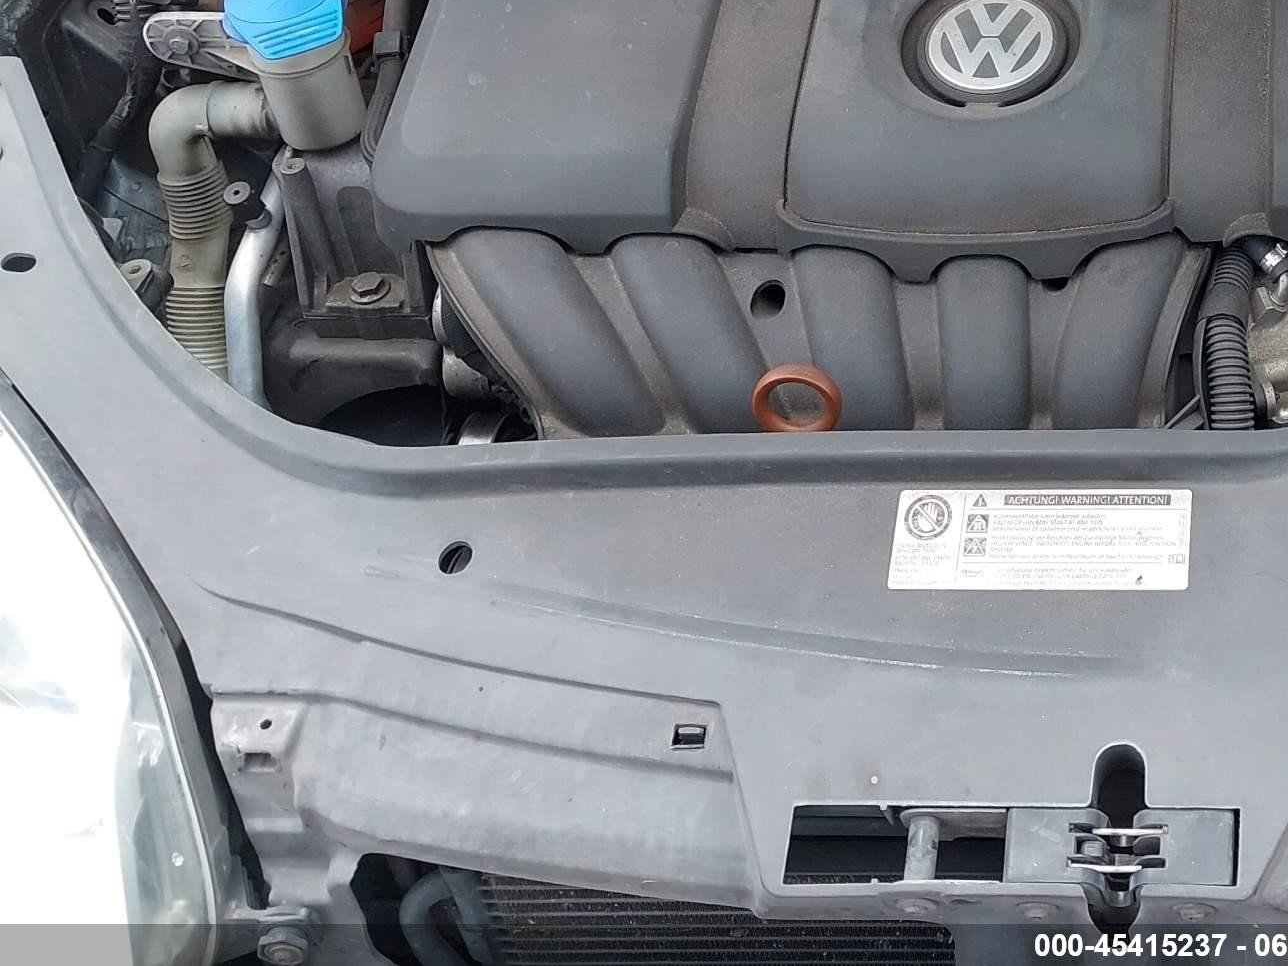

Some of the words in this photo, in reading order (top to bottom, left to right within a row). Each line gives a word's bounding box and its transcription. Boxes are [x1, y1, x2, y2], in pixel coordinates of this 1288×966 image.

[1008, 495, 1060, 506] ACHTUNG!
[1061, 495, 1112, 506] WARNING!
[1113, 495, 1168, 506] ATTENTION!
